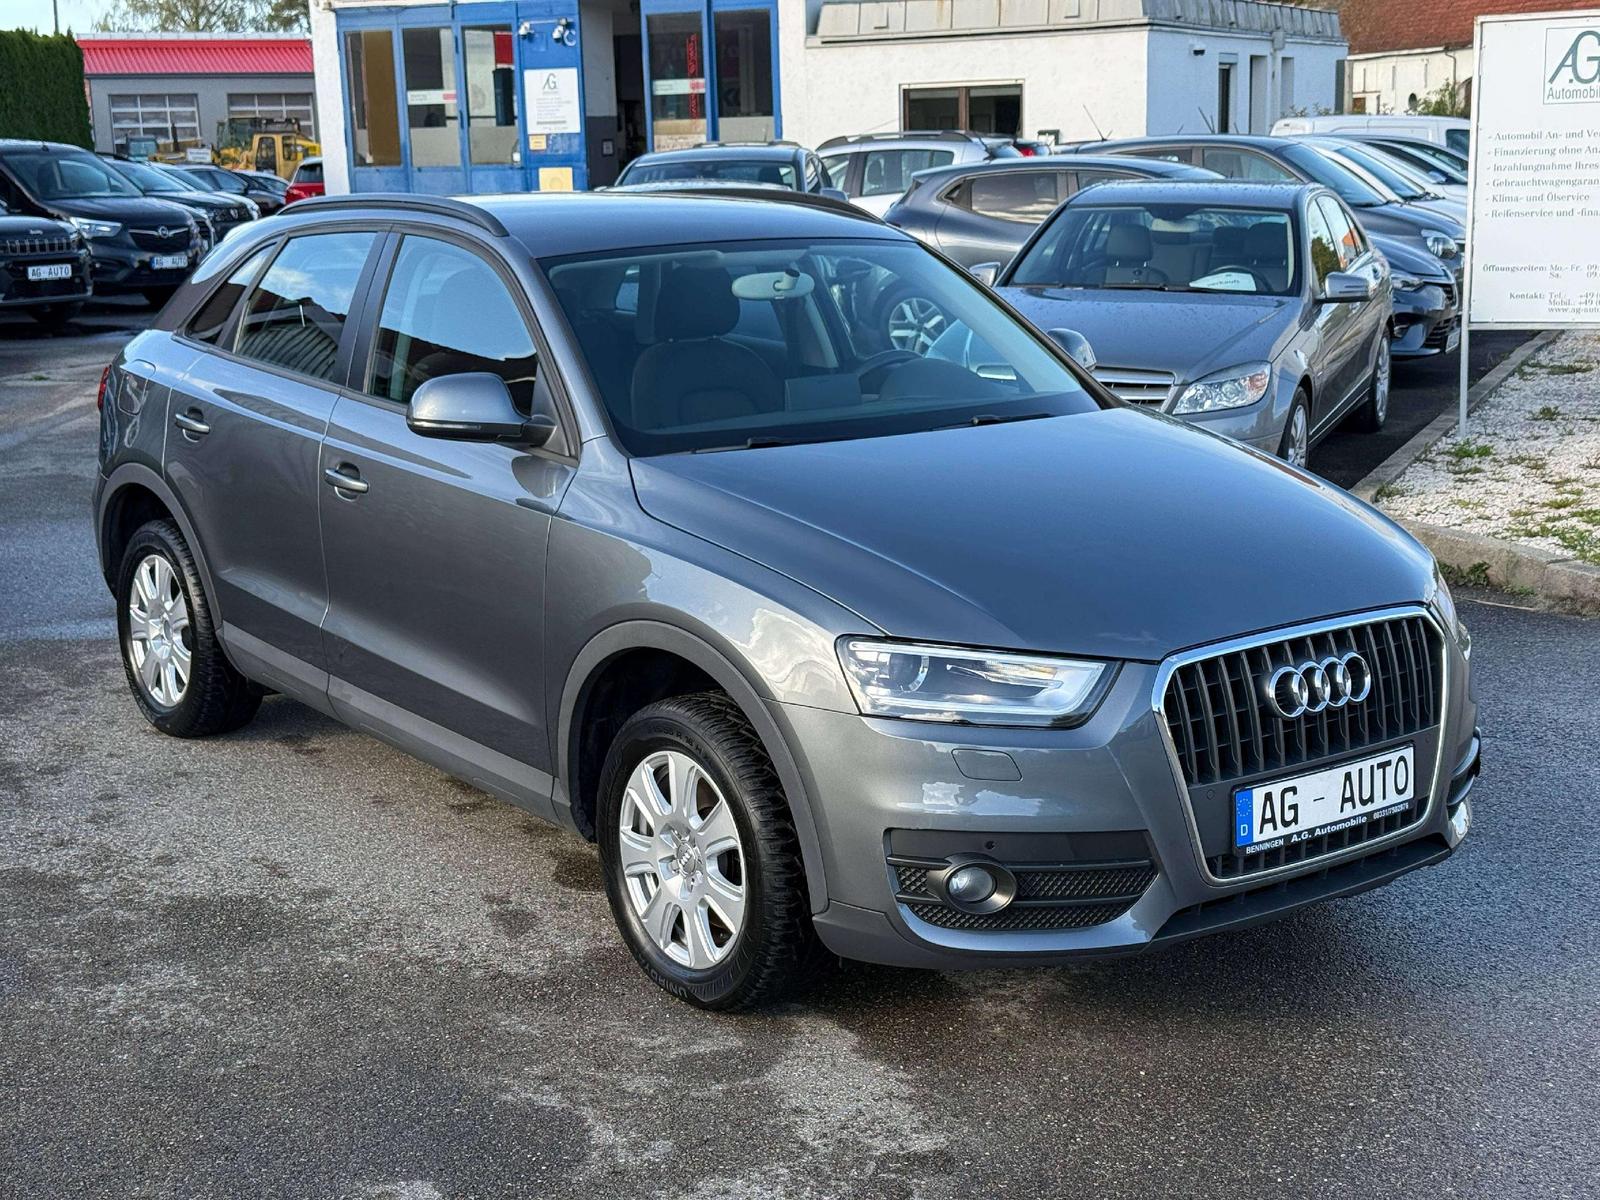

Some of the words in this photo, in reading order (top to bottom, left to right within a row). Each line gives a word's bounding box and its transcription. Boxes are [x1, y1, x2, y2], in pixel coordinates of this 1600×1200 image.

[1495, 131, 1542, 140] Automobil
[1545, 131, 1562, 139] An-
[1565, 129, 1584, 138] und
[1494, 147, 1556, 157] Finanzierung
[1558, 146, 1582, 155] ohne
[1584, 146, 1600, 154] An
[1493, 162, 1572, 173] Inzahlungnahme
[1574, 161, 1599, 170] Ihres
[1492, 178, 1600, 188] Gebrauchtwagengaran
[1492, 194, 1523, 202] Klima-
[1526, 193, 1543, 202] und
[1546, 192, 1590, 202] Ölservice
[1491, 208, 1553, 218] Reifenservice
[1556, 208, 1574, 217] und
[1577, 208, 1600, 217] -fina
[32, 268, 41, 277] AG
[49, 266, 69, 276] AUTO
[1482, 264, 1547, 273] Öffnungszeiten:
[1510, 292, 1545, 300] Kontakt:
[1259, 786, 1299, 835] AG
[1340, 755, 1409, 814] AUTO
[1240, 824, 1249, 837] D
[1246, 838, 1285, 855] BENNINGEN
[1291, 832, 1312, 843] A.G.
[1314, 816, 1368, 837] Automobile
